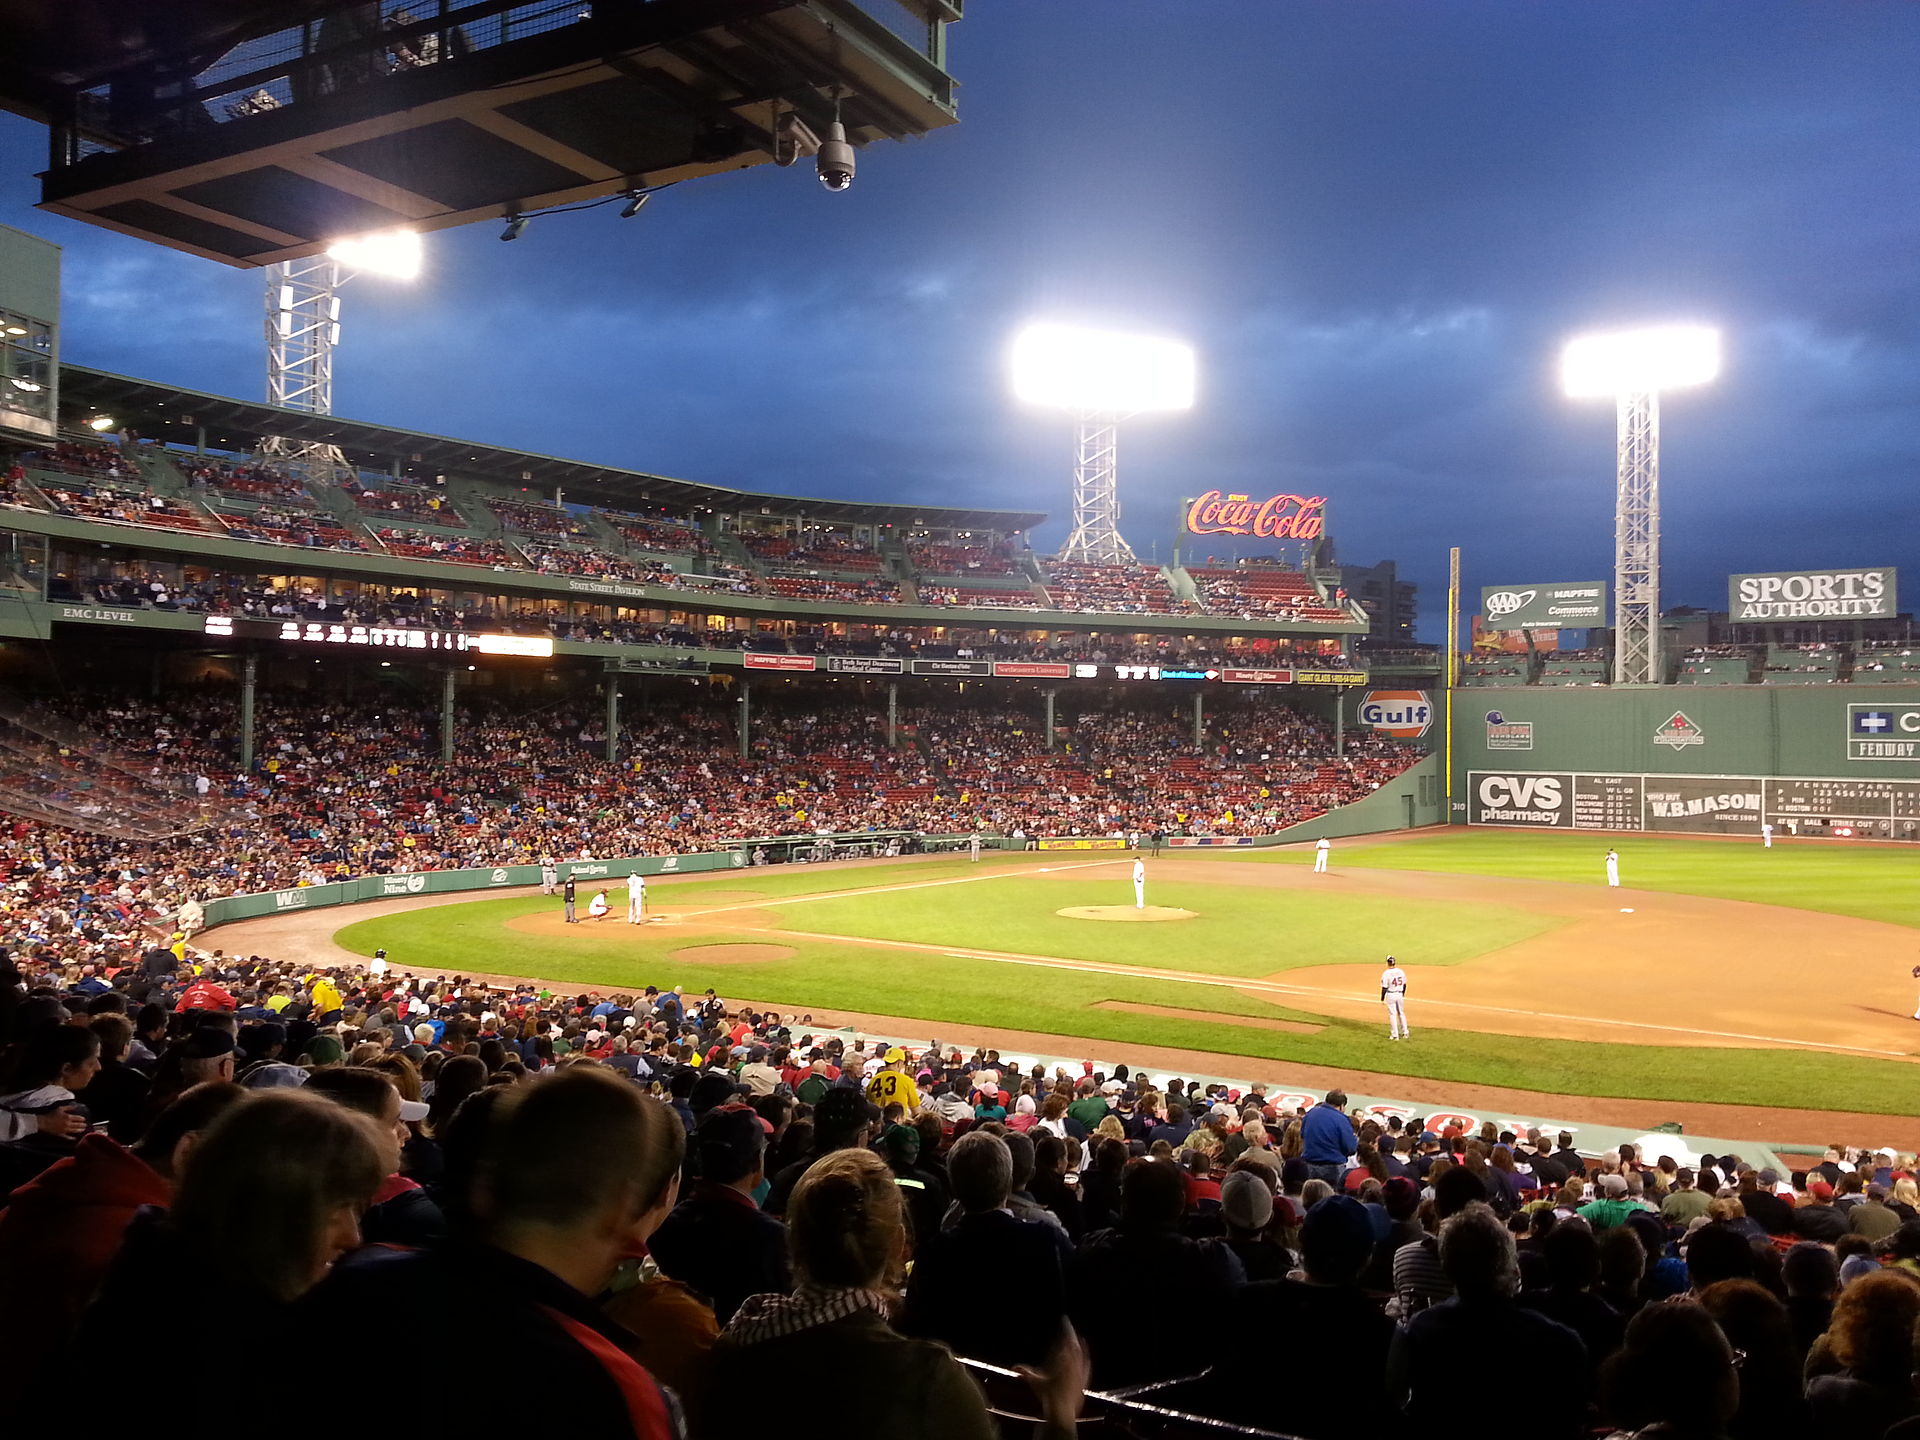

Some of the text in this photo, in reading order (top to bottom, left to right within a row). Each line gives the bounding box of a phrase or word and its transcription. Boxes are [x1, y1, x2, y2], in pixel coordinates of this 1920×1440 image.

[1188, 489, 1328, 540] Coca-Cola
[569, 580, 646, 596] STATE STREET PAVILION
[1554, 589, 1600, 599] MAPFRE
[1740, 572, 1885, 602] SPORTS
[63, 608, 135, 622] EMC LEVEL
[1548, 606, 1600, 616] Commerce
[1363, 704, 1428, 724] Gulf
[1859, 743, 1915, 757] FENWAY
[1480, 776, 1562, 809] CVS
[1452, 802, 1466, 811] 310
[1481, 808, 1560, 825] pharmacy
[1391, 976, 1403, 987] 45
[871, 1075, 898, 1099] 43
